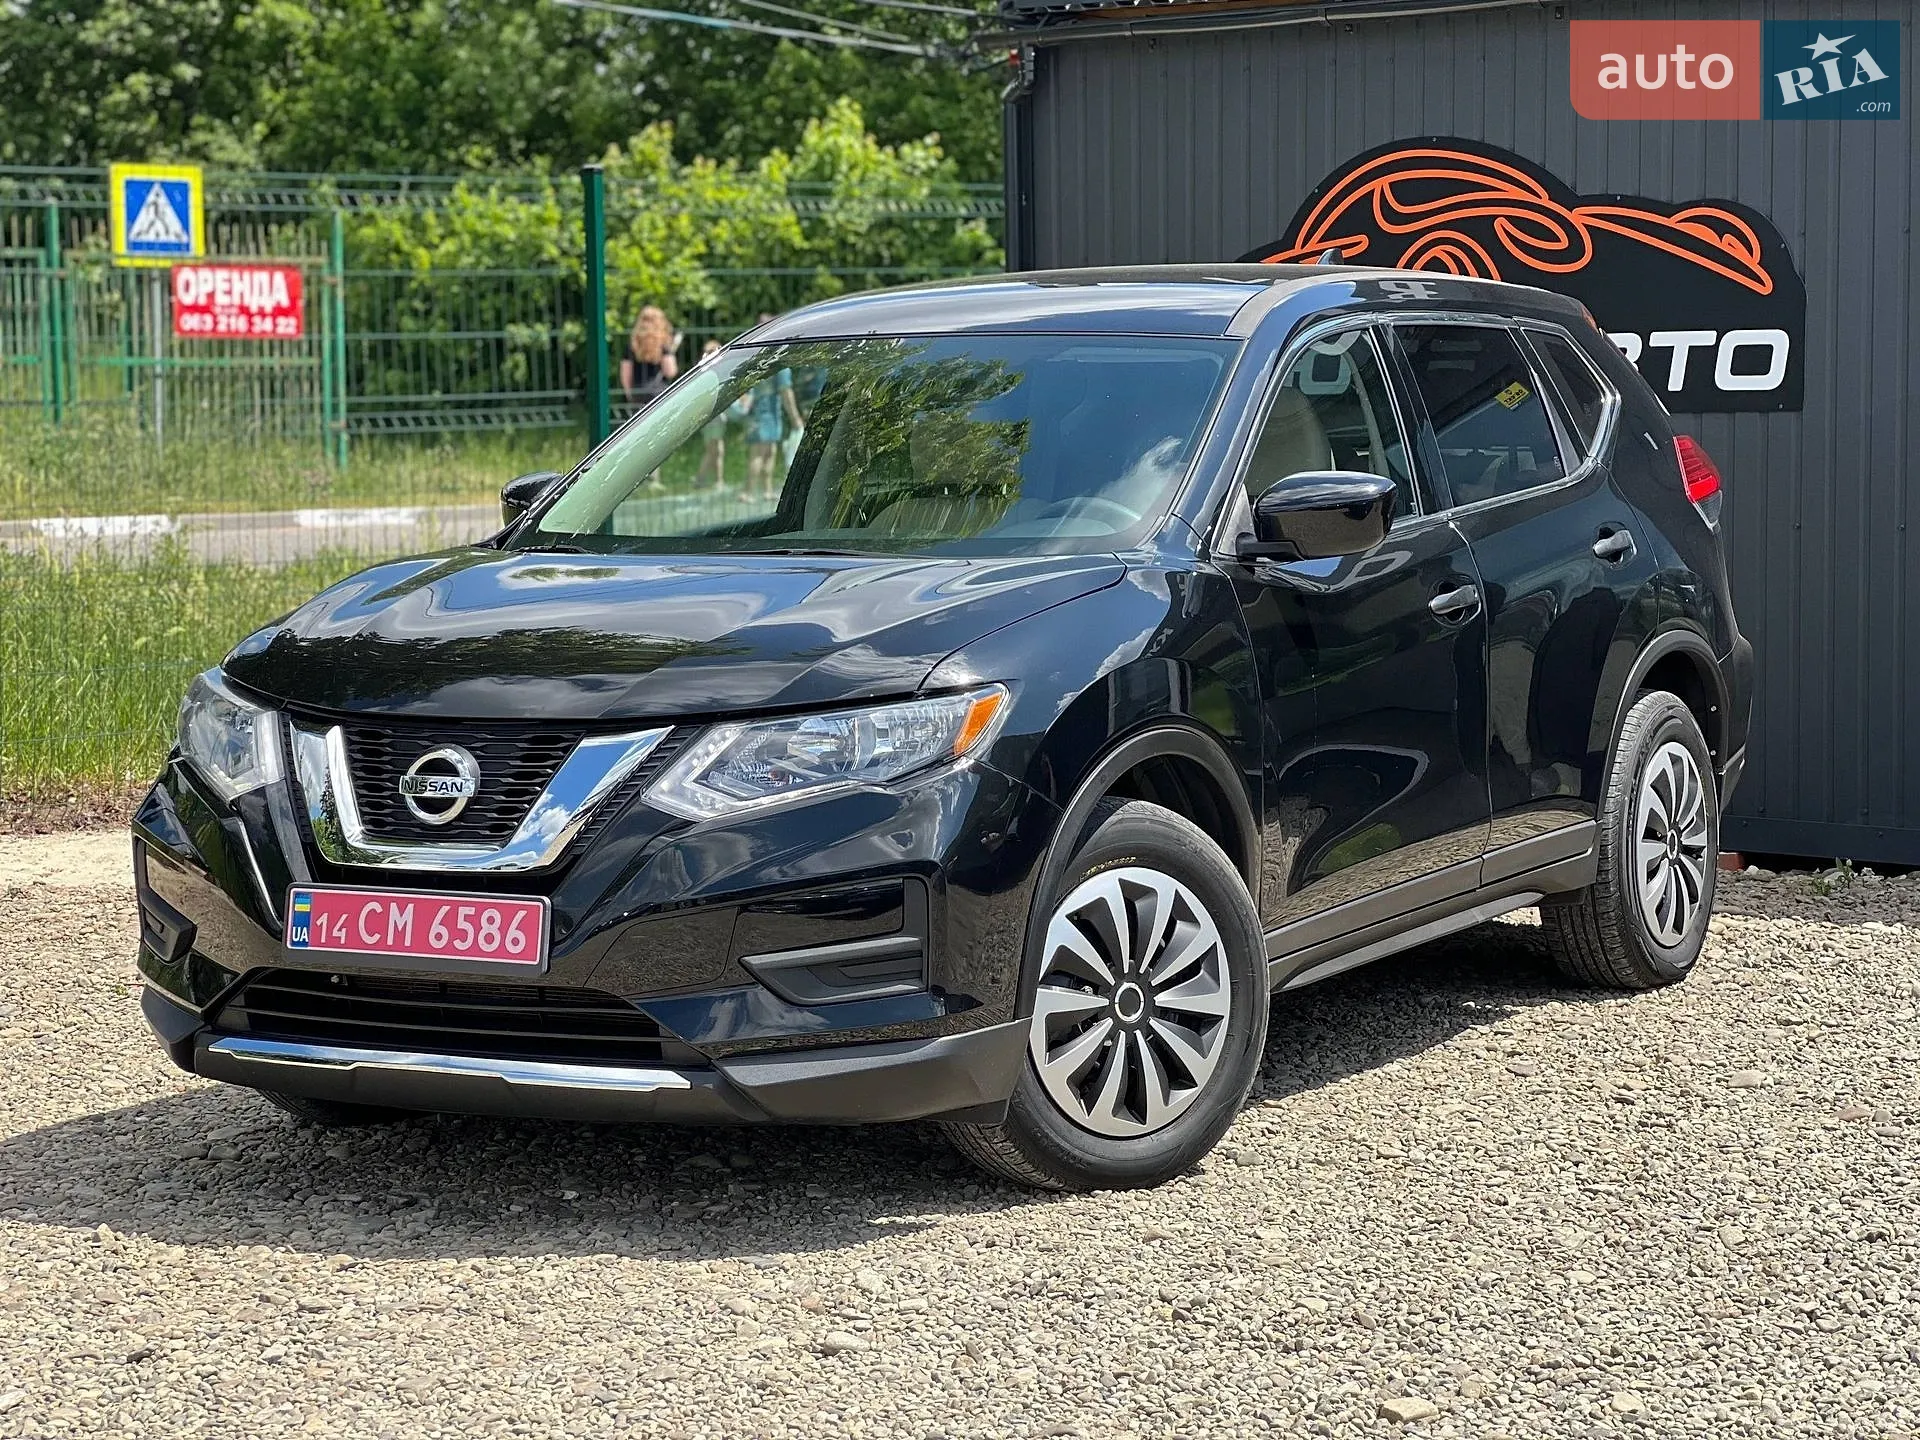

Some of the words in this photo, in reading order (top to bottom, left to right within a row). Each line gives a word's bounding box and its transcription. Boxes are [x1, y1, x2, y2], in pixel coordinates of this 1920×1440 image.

[176, 267, 291, 314] ОРЕНДА
[403, 780, 464, 793] NISSAN
[292, 926, 309, 943] UA
[315, 912, 350, 945] 14
[357, 901, 415, 948] CM
[428, 905, 528, 955] 6586
